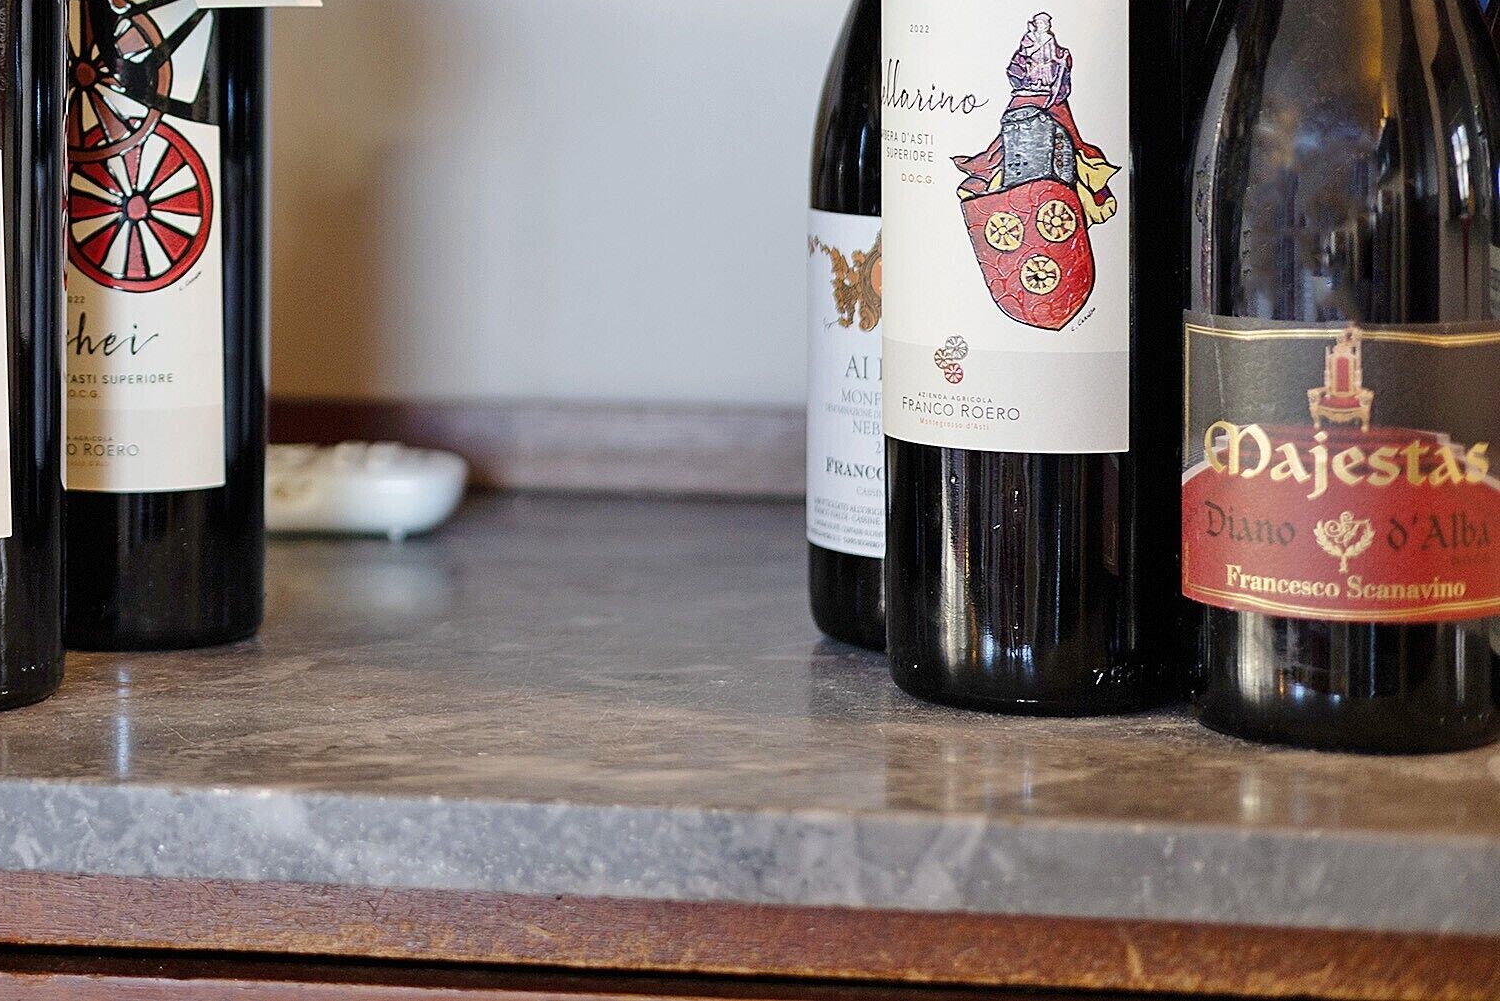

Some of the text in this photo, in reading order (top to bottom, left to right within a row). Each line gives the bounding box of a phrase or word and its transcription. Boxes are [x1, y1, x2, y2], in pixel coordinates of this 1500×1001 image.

[909, 24, 930, 34] 2022
[901, 132, 933, 145] D'ASTI
[886, 146, 934, 163] SUPERIORE
[901, 173, 935, 185] D.O.C.G.
[102, 373, 173, 384] SUPERIORE
[918, 392, 993, 404] AZIENDA AGRICOLA
[902, 396, 1020, 421] FRANCO ROERO
[919, 418, 962, 428] Montegrosso
[83, 443, 140, 457] ROERO
[1204, 420, 1490, 501] Majestas
[1204, 500, 1296, 546] Diano
[1225, 564, 1467, 599] Francesco Scanavino
